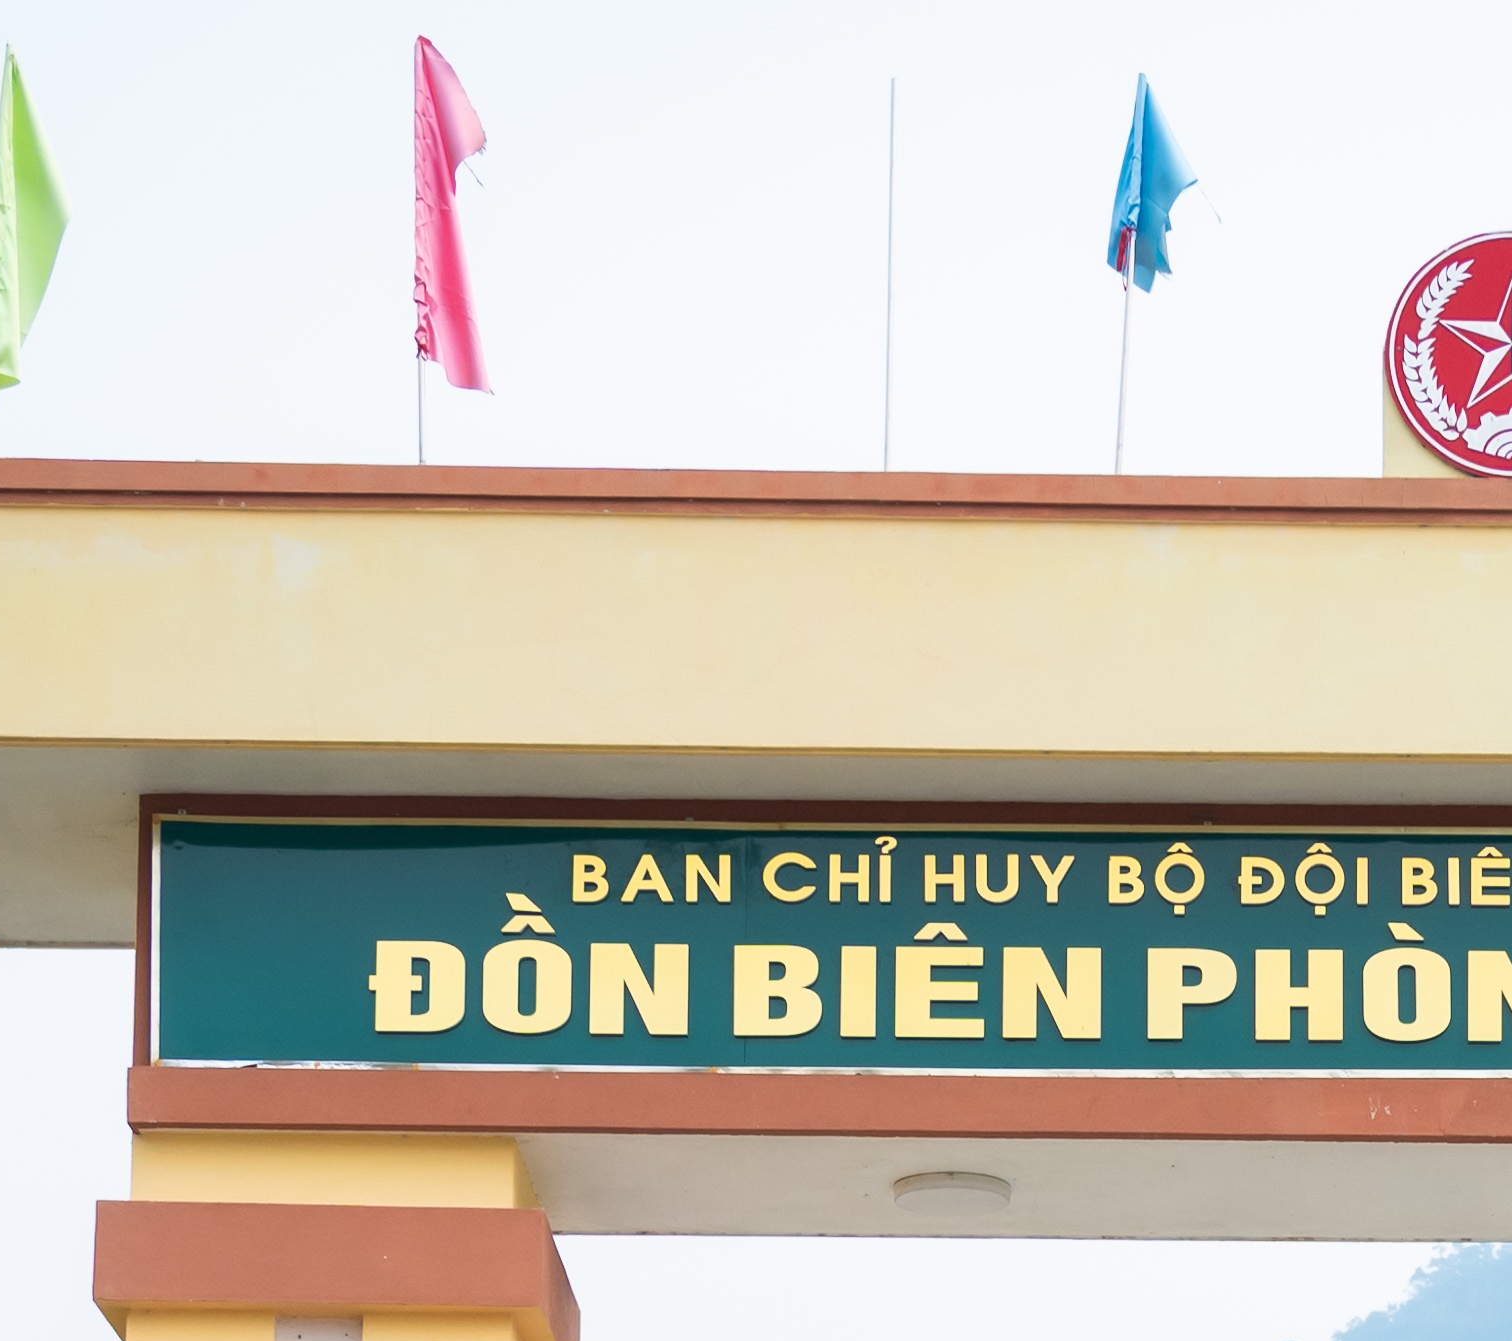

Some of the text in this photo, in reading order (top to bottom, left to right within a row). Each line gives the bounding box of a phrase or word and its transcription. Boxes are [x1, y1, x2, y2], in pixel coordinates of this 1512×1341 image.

[573, 854, 731, 903] BAN
[763, 837, 898, 903] CHỈ
[925, 854, 1075, 903] HUY
[1109, 843, 1205, 915] BỘ
[1238, 843, 1369, 916] ĐỘI
[369, 893, 690, 1036] ĐỒN
[734, 923, 1102, 1039] BIÊN
